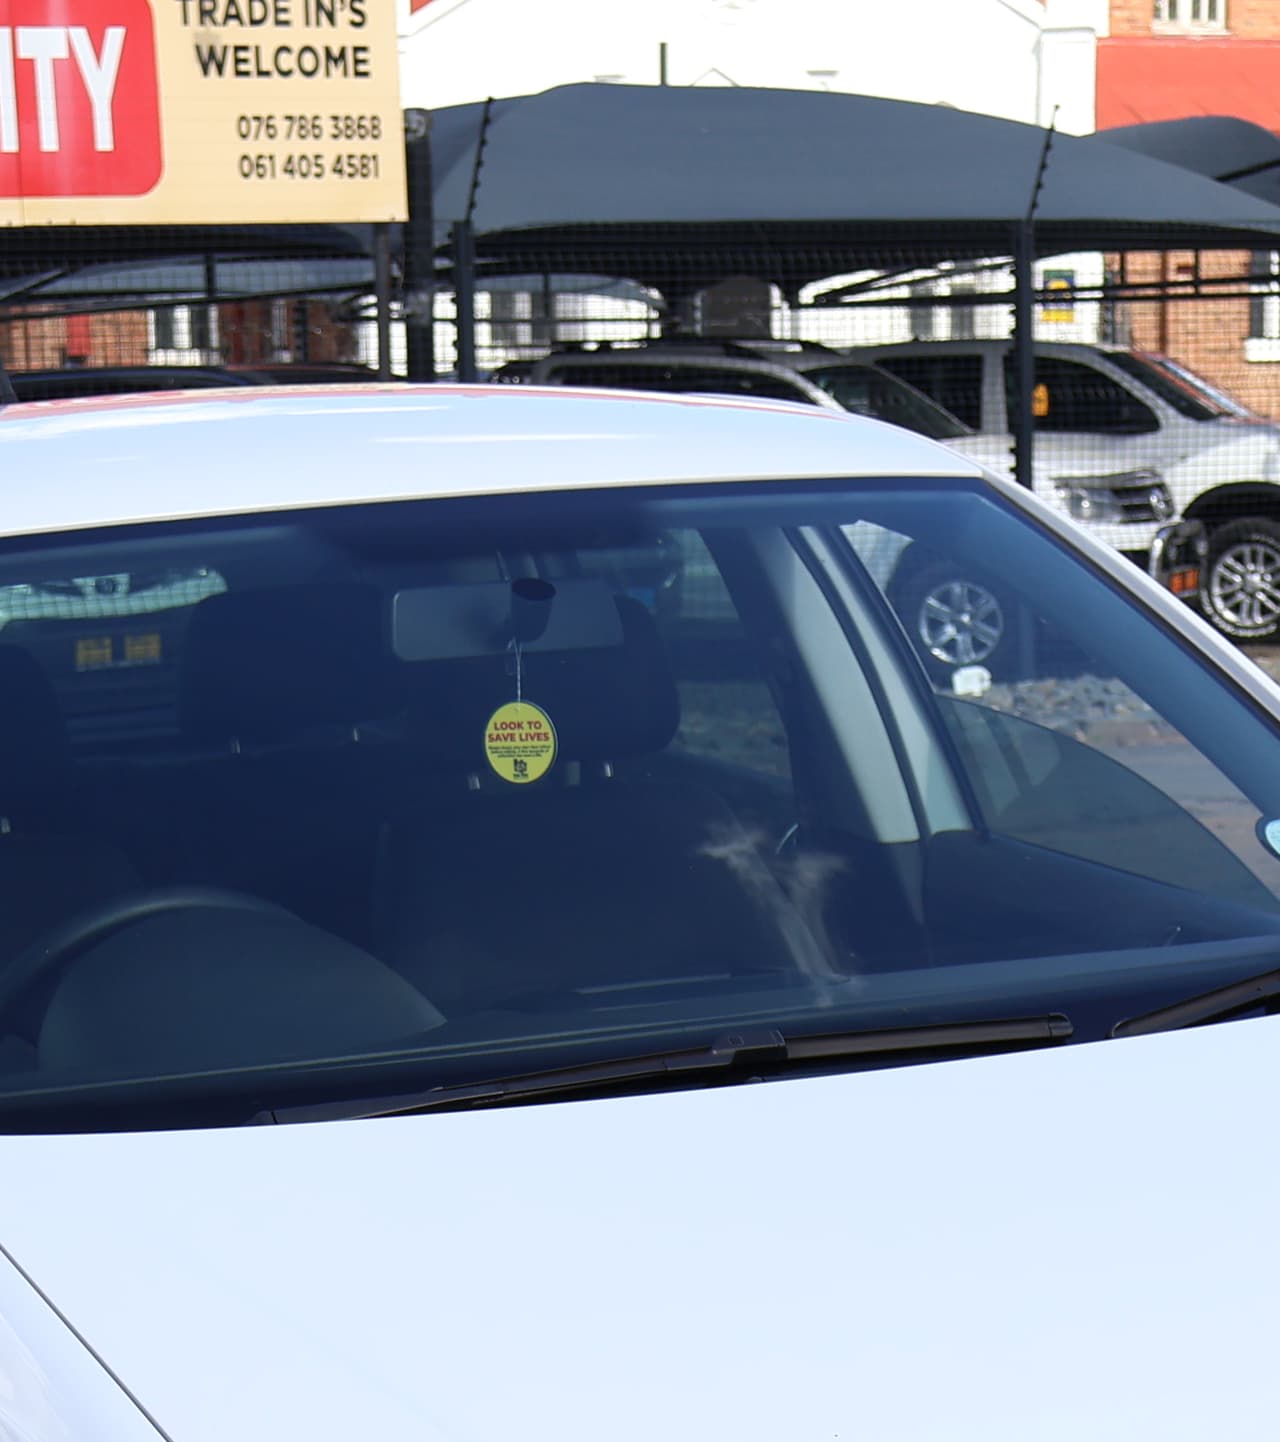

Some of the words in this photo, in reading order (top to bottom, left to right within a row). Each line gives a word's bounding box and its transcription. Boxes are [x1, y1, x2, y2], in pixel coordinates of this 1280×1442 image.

[180, 0, 292, 27] TRADE
[195, 44, 371, 78] WELCOME
[237, 115, 277, 140] 076
[284, 115, 322, 140] 786
[330, 115, 381, 140] 3868
[239, 154, 276, 179] 061
[283, 154, 324, 179] 405
[331, 154, 380, 179] 4581
[488, 733, 517, 743] SAVE
[519, 732, 550, 742] LIVES
[493, 721, 524, 731] LOOK
[527, 720, 542, 730] TO
